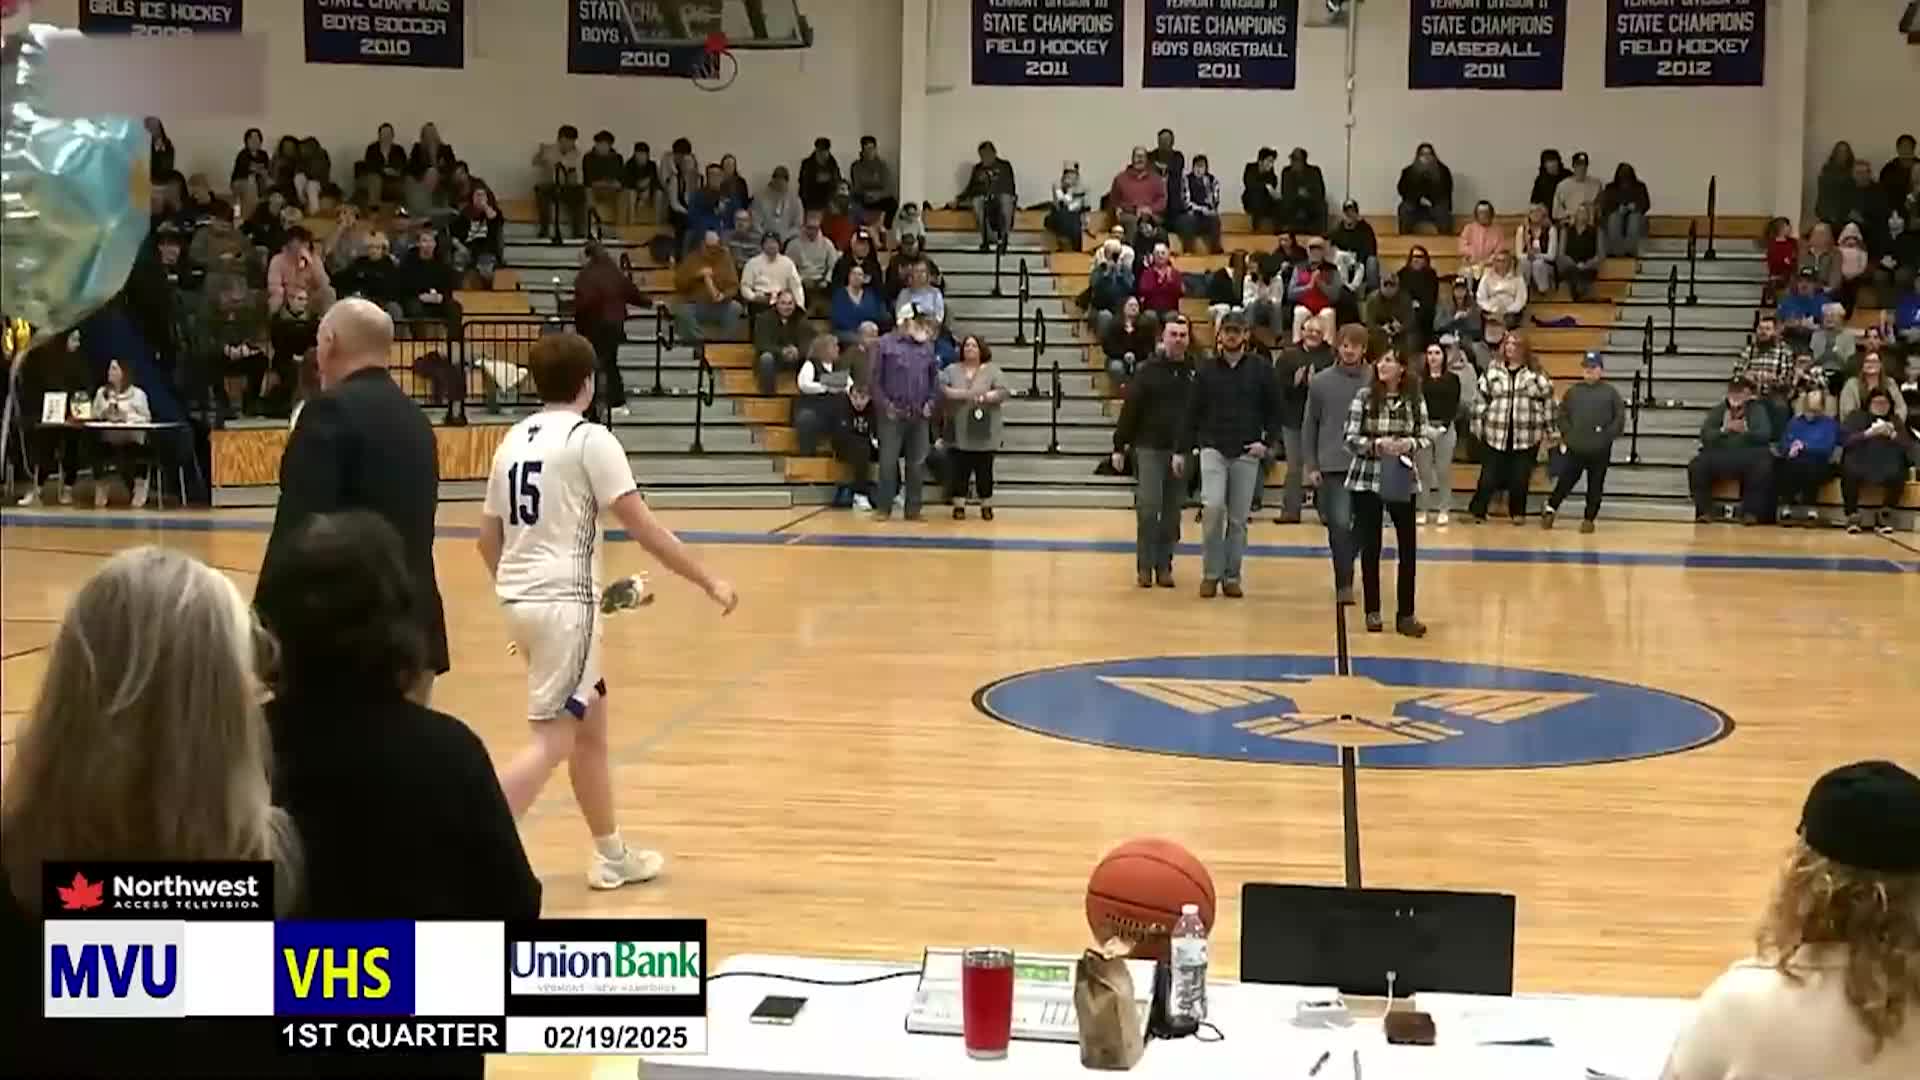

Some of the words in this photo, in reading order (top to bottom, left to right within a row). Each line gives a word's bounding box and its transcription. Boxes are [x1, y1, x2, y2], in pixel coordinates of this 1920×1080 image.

[89, 0, 135, 15] GIRLS
[140, 2, 166, 18] ICE
[171, 4, 232, 22] HOCKEY
[322, 14, 370, 31] BOYS
[374, 16, 446, 34] SOCCER
[983, 13, 1028, 33] STATE
[1033, 13, 1113, 33] CHAMPIONS
[1156, 15, 1200, 34] STATE
[1205, 15, 1286, 35] CHAMPIONS
[1421, 15, 1466, 35] STATE
[1471, 15, 1553, 35] CHAMPIONS
[1617, 13, 1664, 33] STATE
[1669, 12, 1754, 33] CHAMPIONS
[581, 27, 619, 43] BOYS
[360, 39, 410, 55] 2010
[985, 38, 1035, 54] FIELD
[1040, 38, 1109, 55] HOCKEY
[1152, 41, 1188, 56] BOYS
[1193, 41, 1288, 57] BASKETBALL
[1431, 41, 1541, 57] BASEBALL
[1619, 39, 1673, 55] FIELD
[1677, 38, 1749, 55] HOCKEY
[620, 51, 670, 67] 2010
[1025, 61, 1069, 76] 2011
[1197, 63, 1242, 79] 2011
[1464, 63, 1506, 78] 2011
[1656, 60, 1712, 76] 2012
[508, 461, 542, 525] 15
